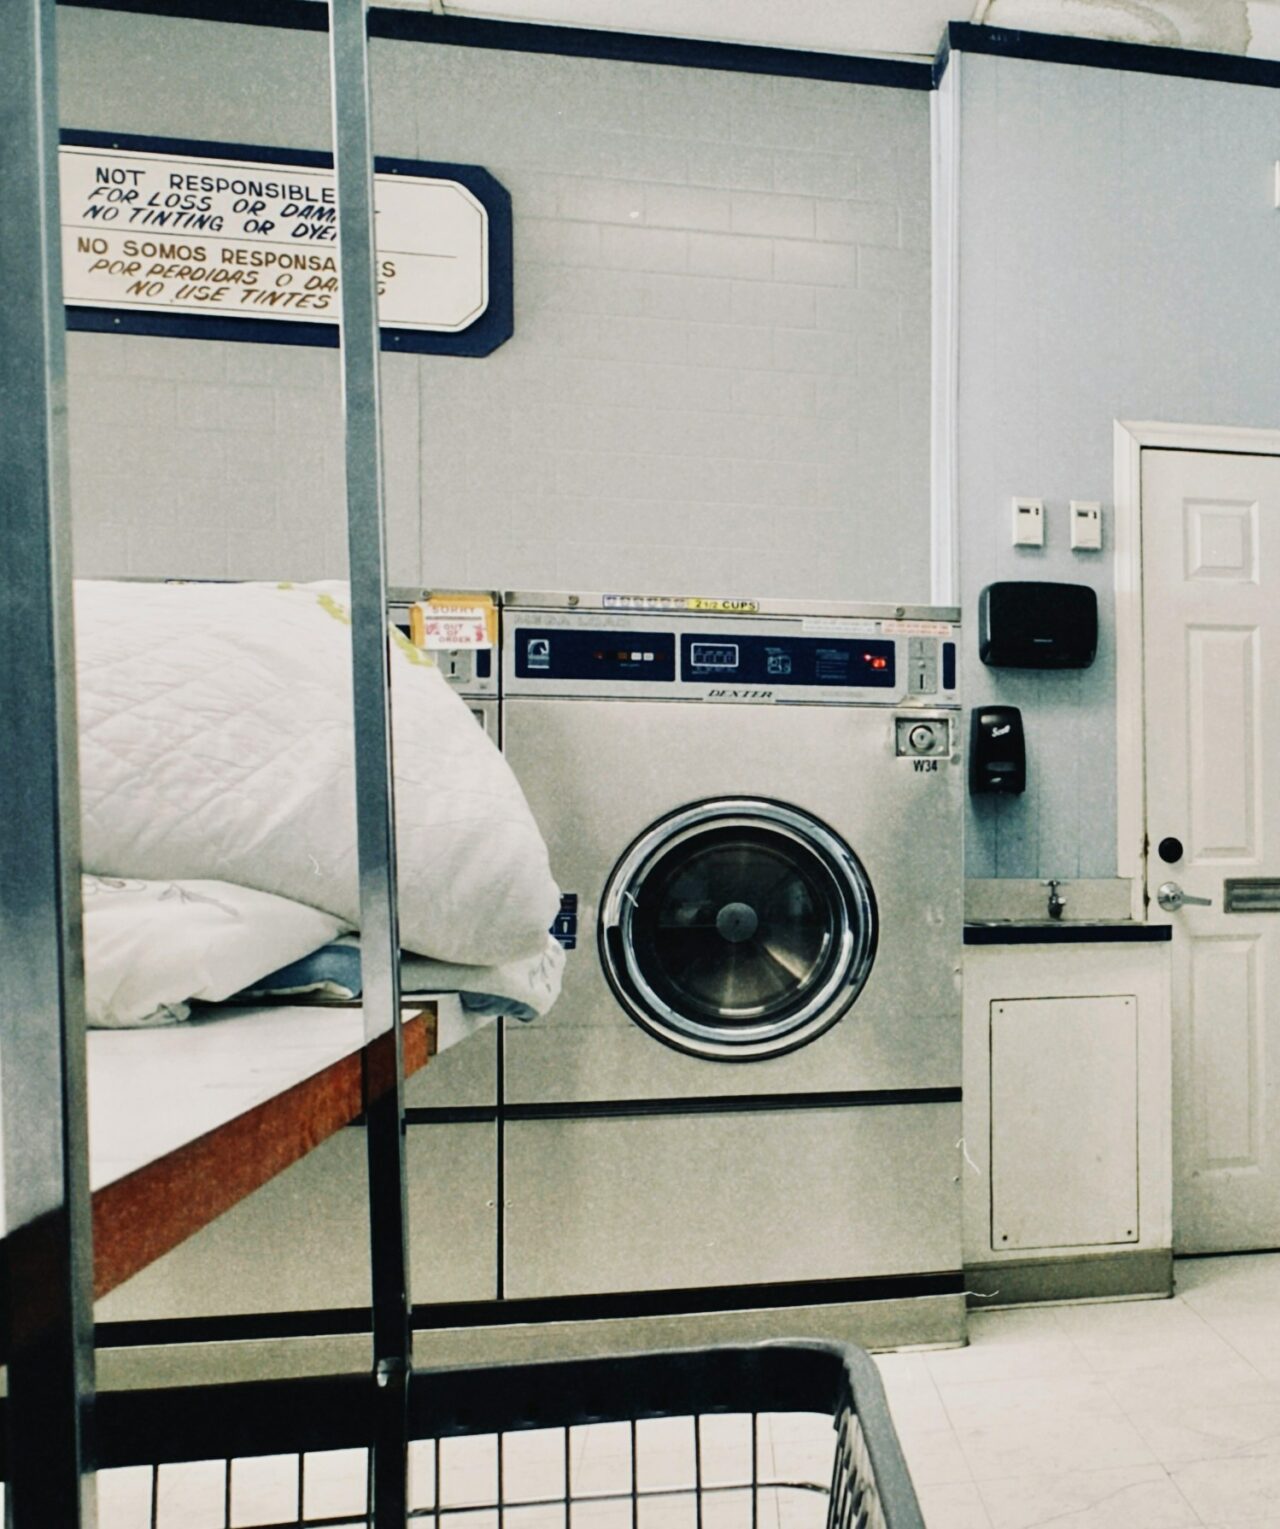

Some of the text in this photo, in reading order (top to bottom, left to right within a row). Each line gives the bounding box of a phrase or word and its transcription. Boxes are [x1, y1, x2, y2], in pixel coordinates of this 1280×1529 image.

[96, 167, 335, 204] NOT RESPONSIBLE
[87, 187, 139, 204] FOR
[147, 192, 213, 212] LOSS
[232, 199, 266, 217] OR
[82, 205, 119, 221] NO
[129, 207, 224, 232] TINTING
[243, 219, 275, 235] OR
[77, 237, 396, 278] NO SOMOS RESPONSAS
[88, 258, 142, 276] POR
[145, 263, 259, 286] PERDIDAS
[275, 273, 293, 287] O
[126, 280, 332, 309] NO USE TINTES
[722, 600, 756, 610] CUPS
[707, 689, 773, 698] DEXTER
[913, 759, 938, 772] W34
